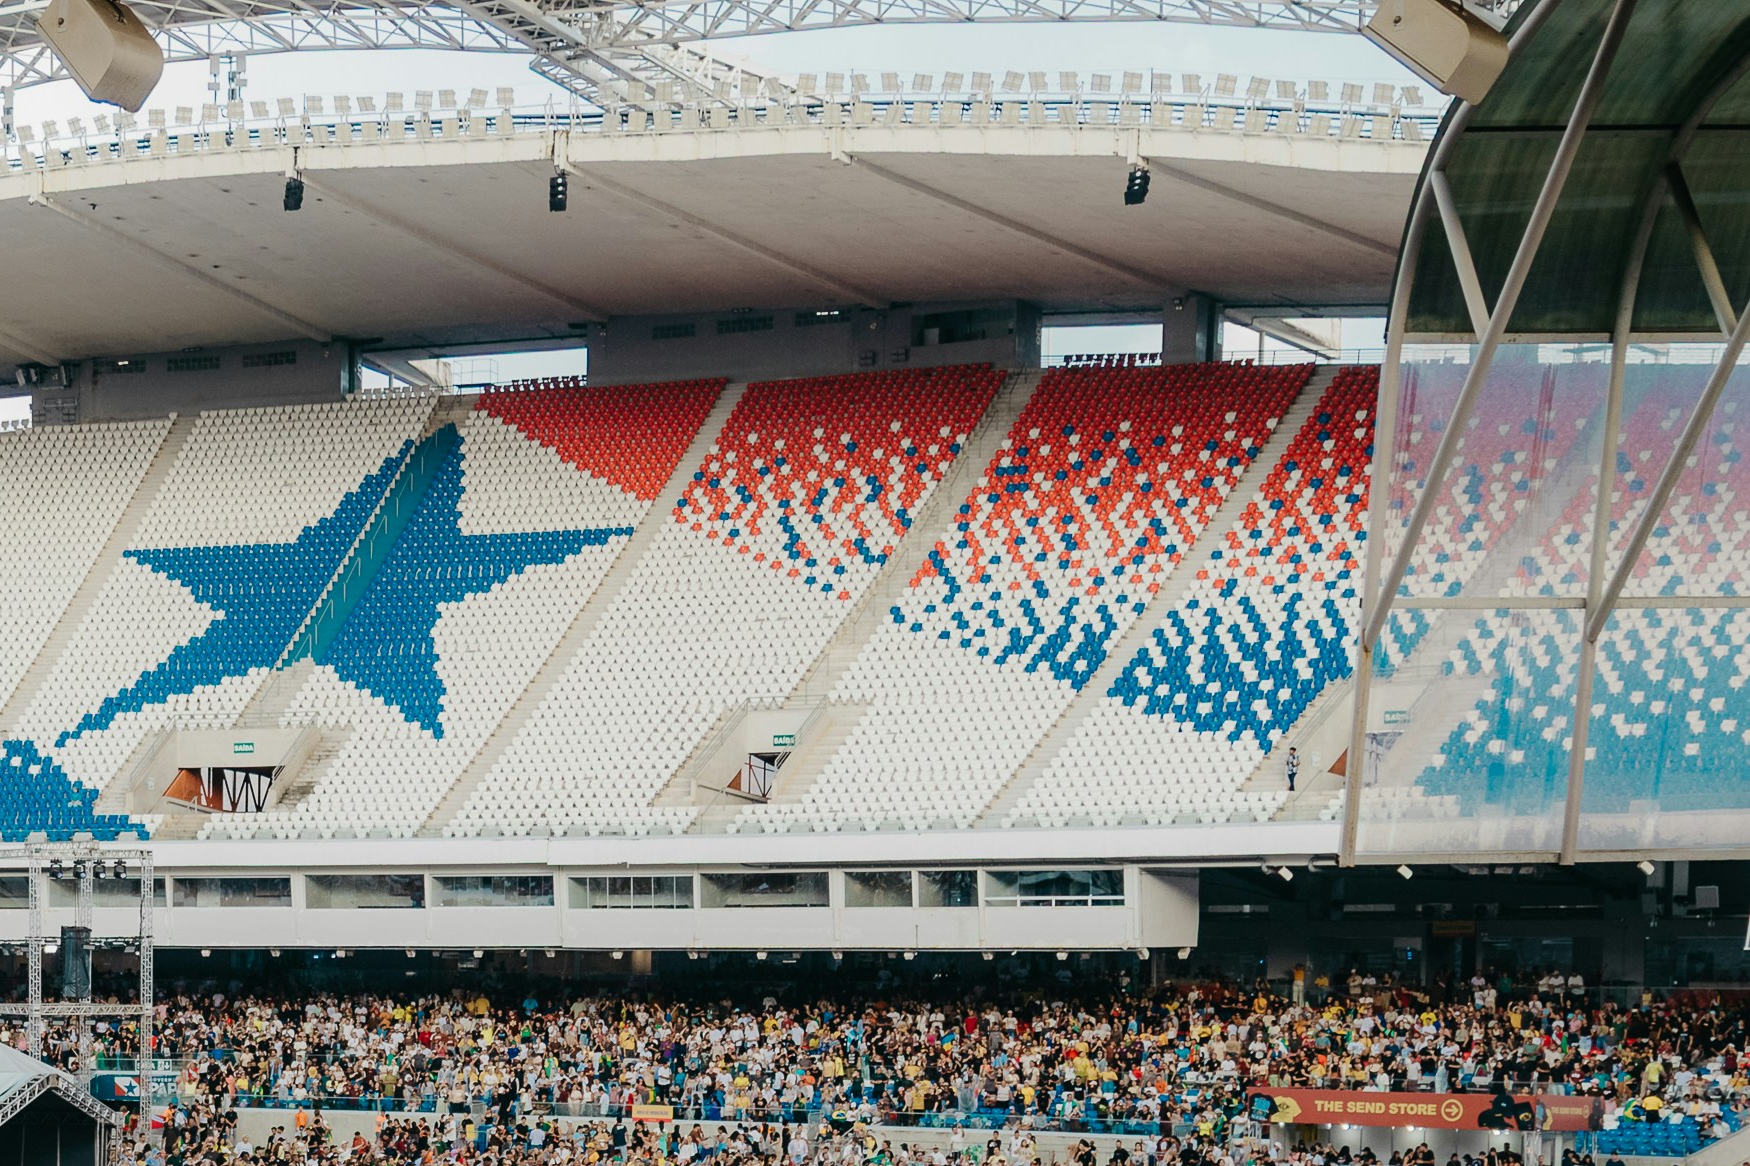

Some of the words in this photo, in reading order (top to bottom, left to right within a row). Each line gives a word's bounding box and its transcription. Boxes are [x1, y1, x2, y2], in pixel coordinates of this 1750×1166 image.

[1315, 1100, 1344, 1113] THE
[1347, 1101, 1386, 1114] SEND
[1388, 1102, 1437, 1115] STORE
